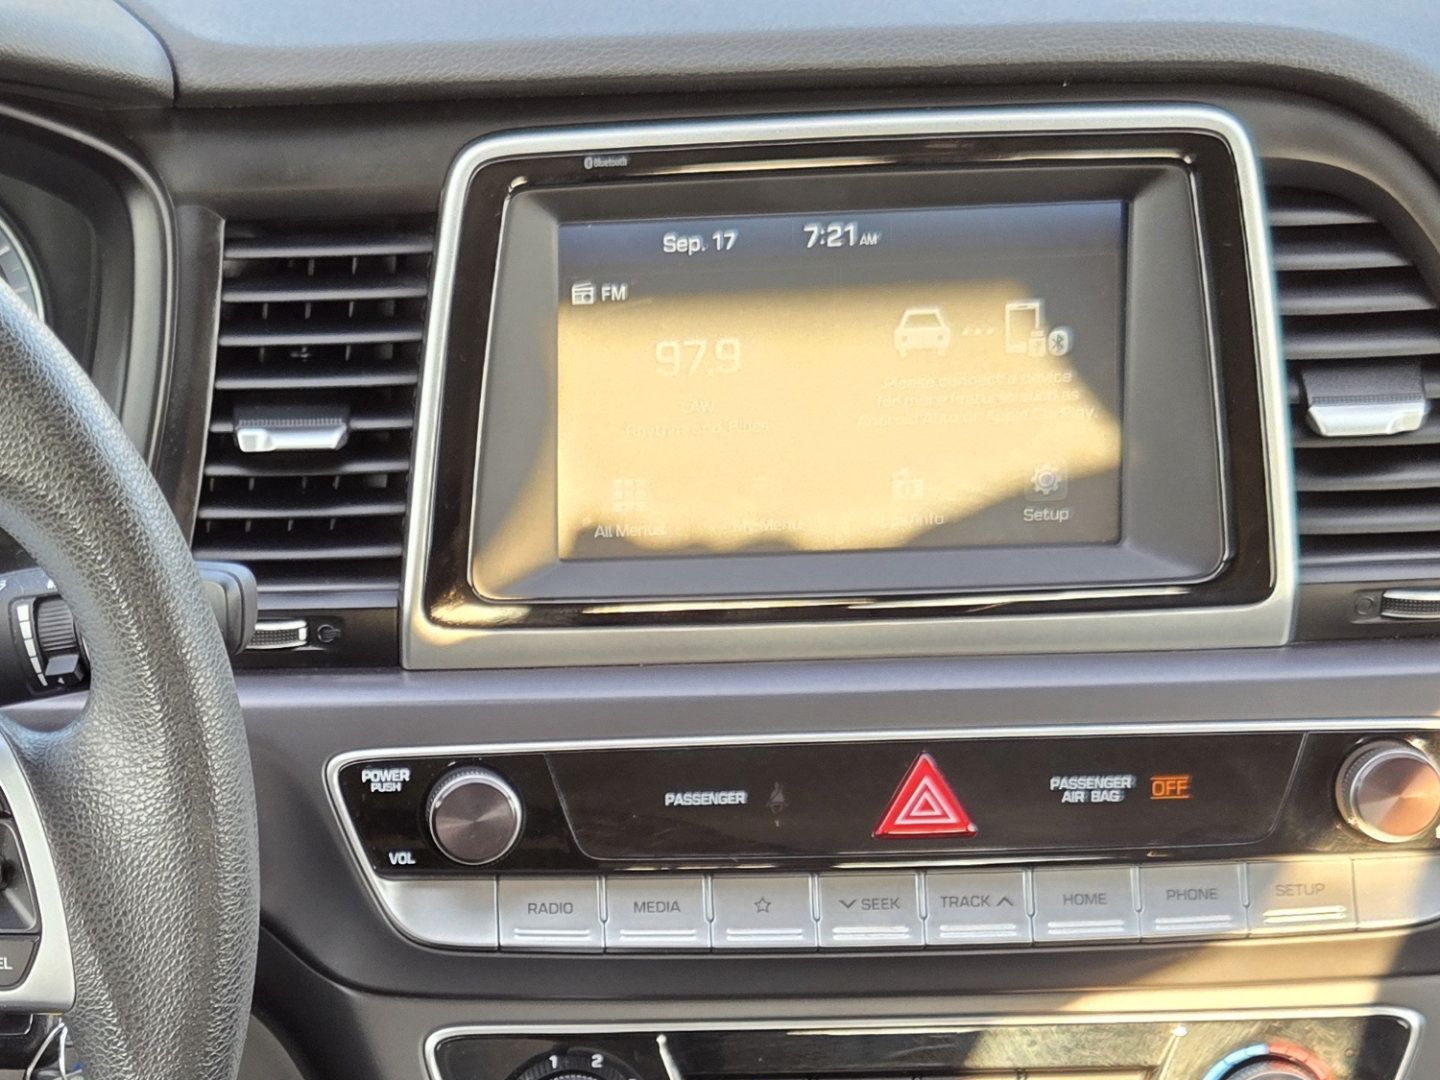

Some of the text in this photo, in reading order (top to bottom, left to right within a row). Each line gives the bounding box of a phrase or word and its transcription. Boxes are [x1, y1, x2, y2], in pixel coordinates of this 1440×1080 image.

[593, 157, 628, 167] Bluetooth
[663, 230, 738, 256] Sep. 17
[601, 284, 627, 301] FM
[1023, 508, 1070, 523] Setup
[594, 525, 613, 539] All
[361, 768, 410, 783] POWER
[1050, 774, 1135, 790] PASSENGER
[370, 782, 402, 792] PUSH
[1151, 779, 1189, 796] OFF
[665, 791, 747, 807] PASSENGER
[1061, 789, 1123, 803] AIR BAG
[388, 851, 416, 865] VOL
[1165, 887, 1218, 902] PHONE
[1275, 882, 1325, 897] SETUP
[861, 897, 900, 911] SEEK
[940, 894, 991, 909] TRACK
[1063, 892, 1107, 906] HOME
[527, 902, 574, 915] RADIO
[633, 900, 681, 914] MEDIA
[548, 1055, 559, 1069] 1
[591, 1054, 604, 1069] 2
